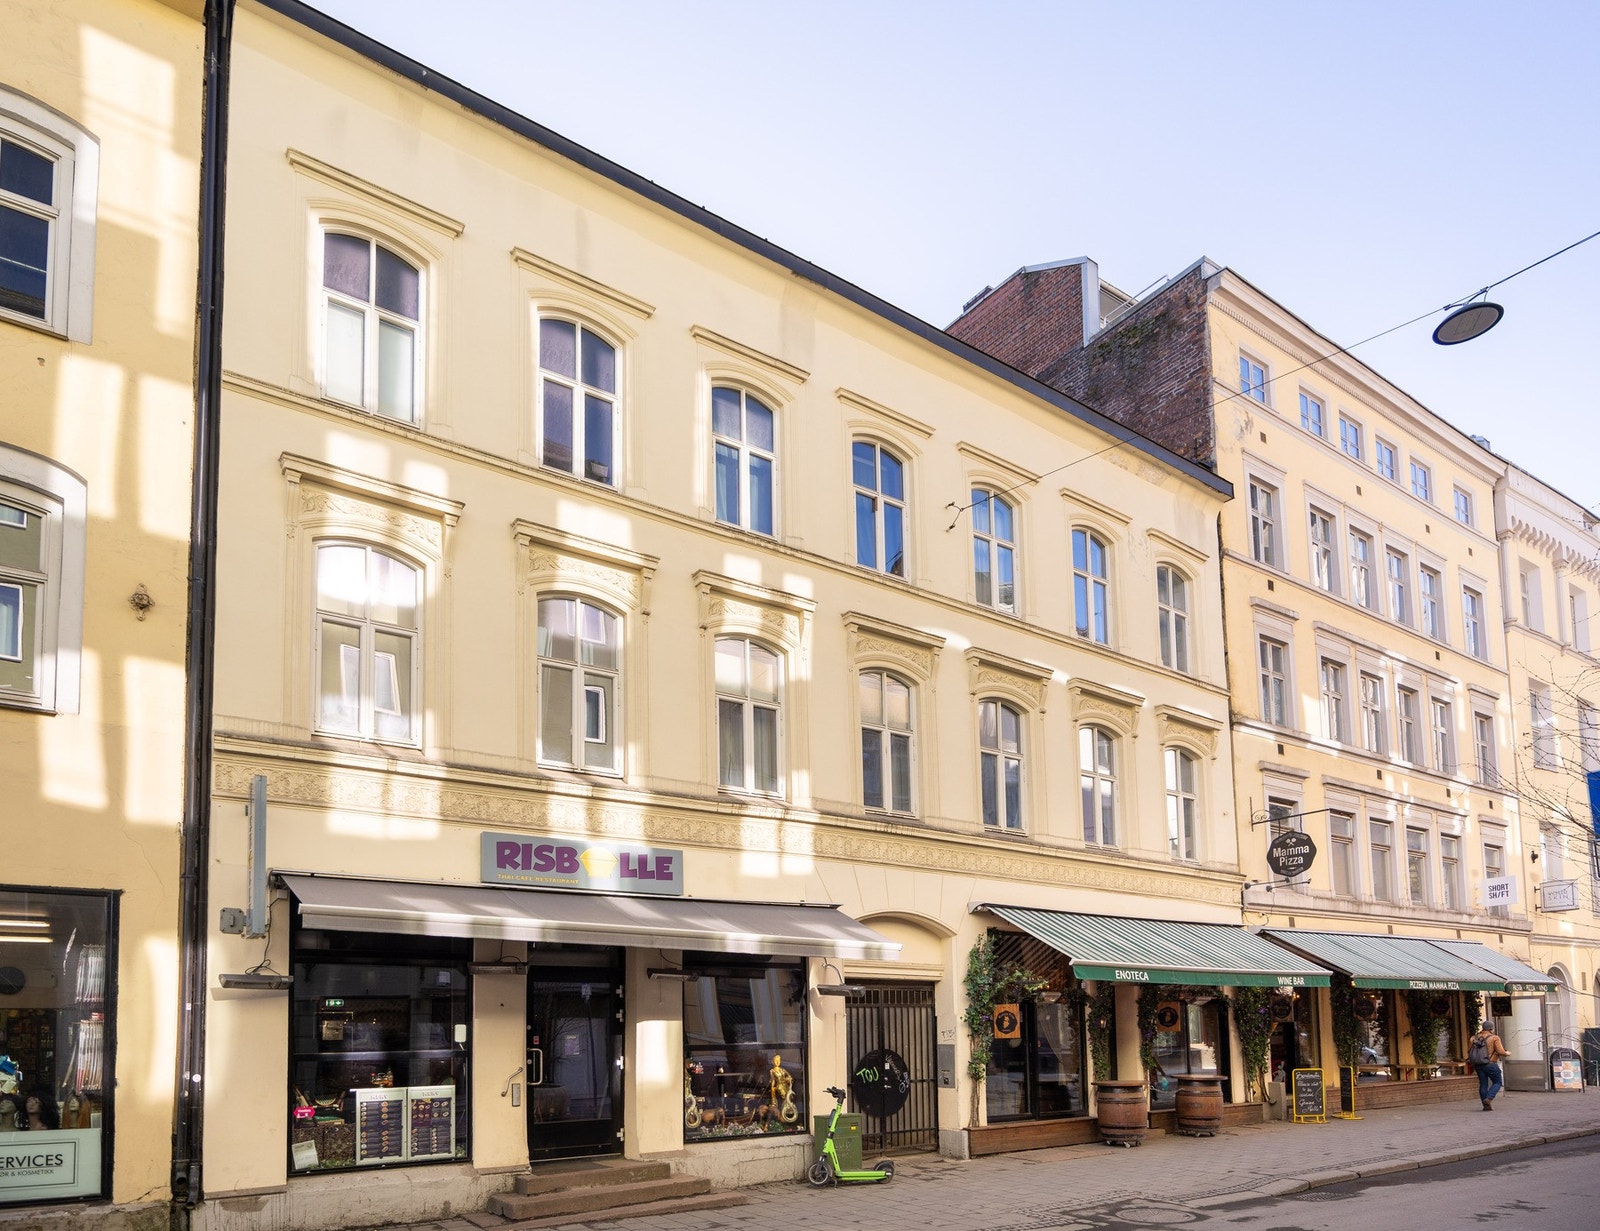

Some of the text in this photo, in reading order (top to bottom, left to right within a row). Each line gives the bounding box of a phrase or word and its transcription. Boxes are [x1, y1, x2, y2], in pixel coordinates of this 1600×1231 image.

[1273, 845, 1310, 858] Mamma
[1279, 856, 1304, 867] Pizza
[535, 876, 579, 885] RESTAURANT
[1488, 883, 1509, 892] SHORT
[1115, 970, 1305, 985] ENOTECA WINE BAR
[17, 1169, 54, 1177] KOSMETIKK
